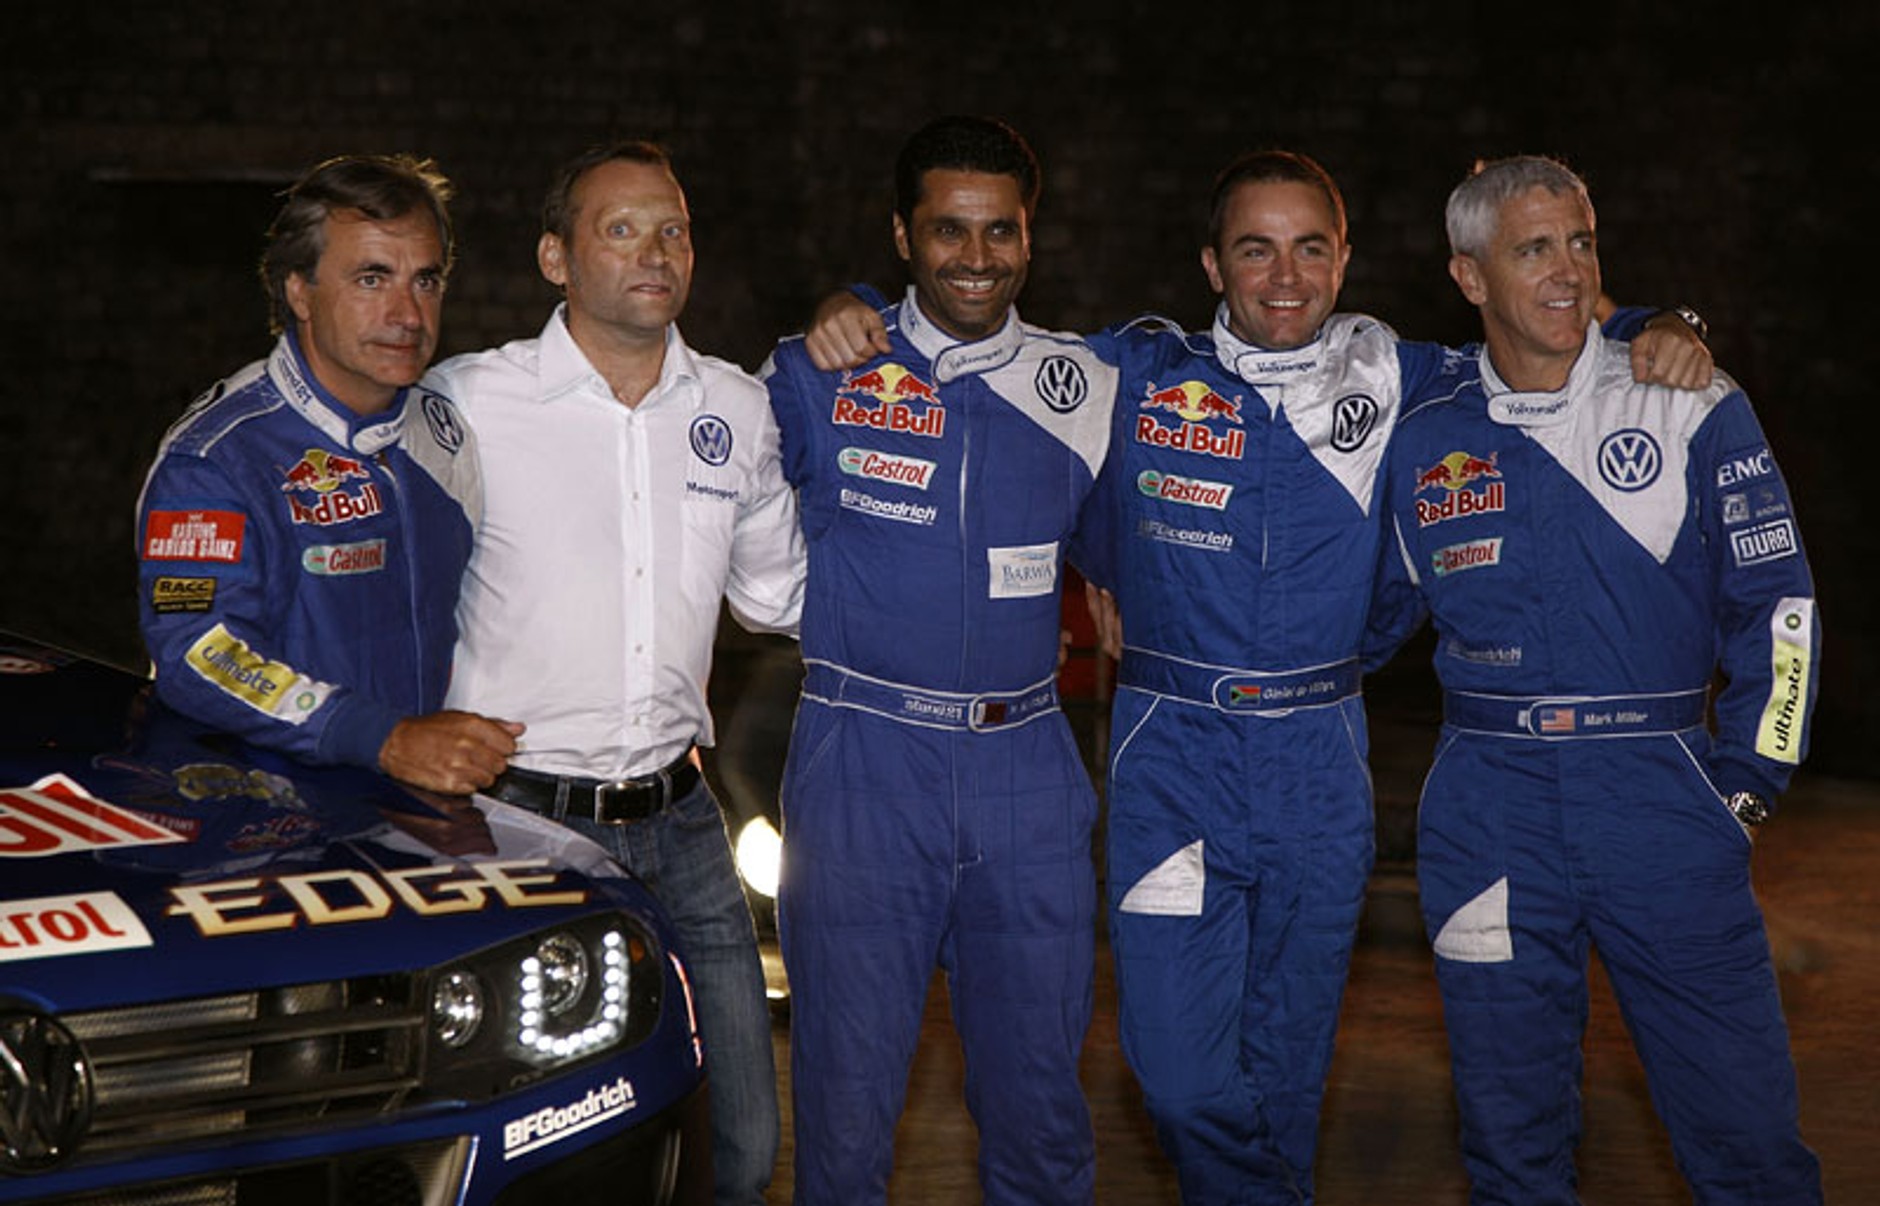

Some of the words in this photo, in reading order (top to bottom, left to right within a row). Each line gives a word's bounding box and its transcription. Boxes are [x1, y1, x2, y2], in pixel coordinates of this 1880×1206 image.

[834, 396, 888, 427] Red
[890, 405, 944, 436] Bull
[1136, 415, 1188, 449] Red
[1190, 425, 1244, 458] Bull
[862, 453, 928, 485] Castrol
[332, 482, 383, 521] Bull
[840, 488, 938, 521] BFGoodrich
[1160, 477, 1226, 507] Castrol
[1416, 491, 1454, 525] Red
[1459, 483, 1503, 515] Bull
[1139, 519, 1234, 547] FGoodrich
[1443, 541, 1496, 571] Castrol
[158, 580, 210, 593] RACC
[1774, 657, 1802, 751] ultimate
[162, 858, 590, 939] EDGE
[502, 1076, 636, 1151] BFGoodrich
